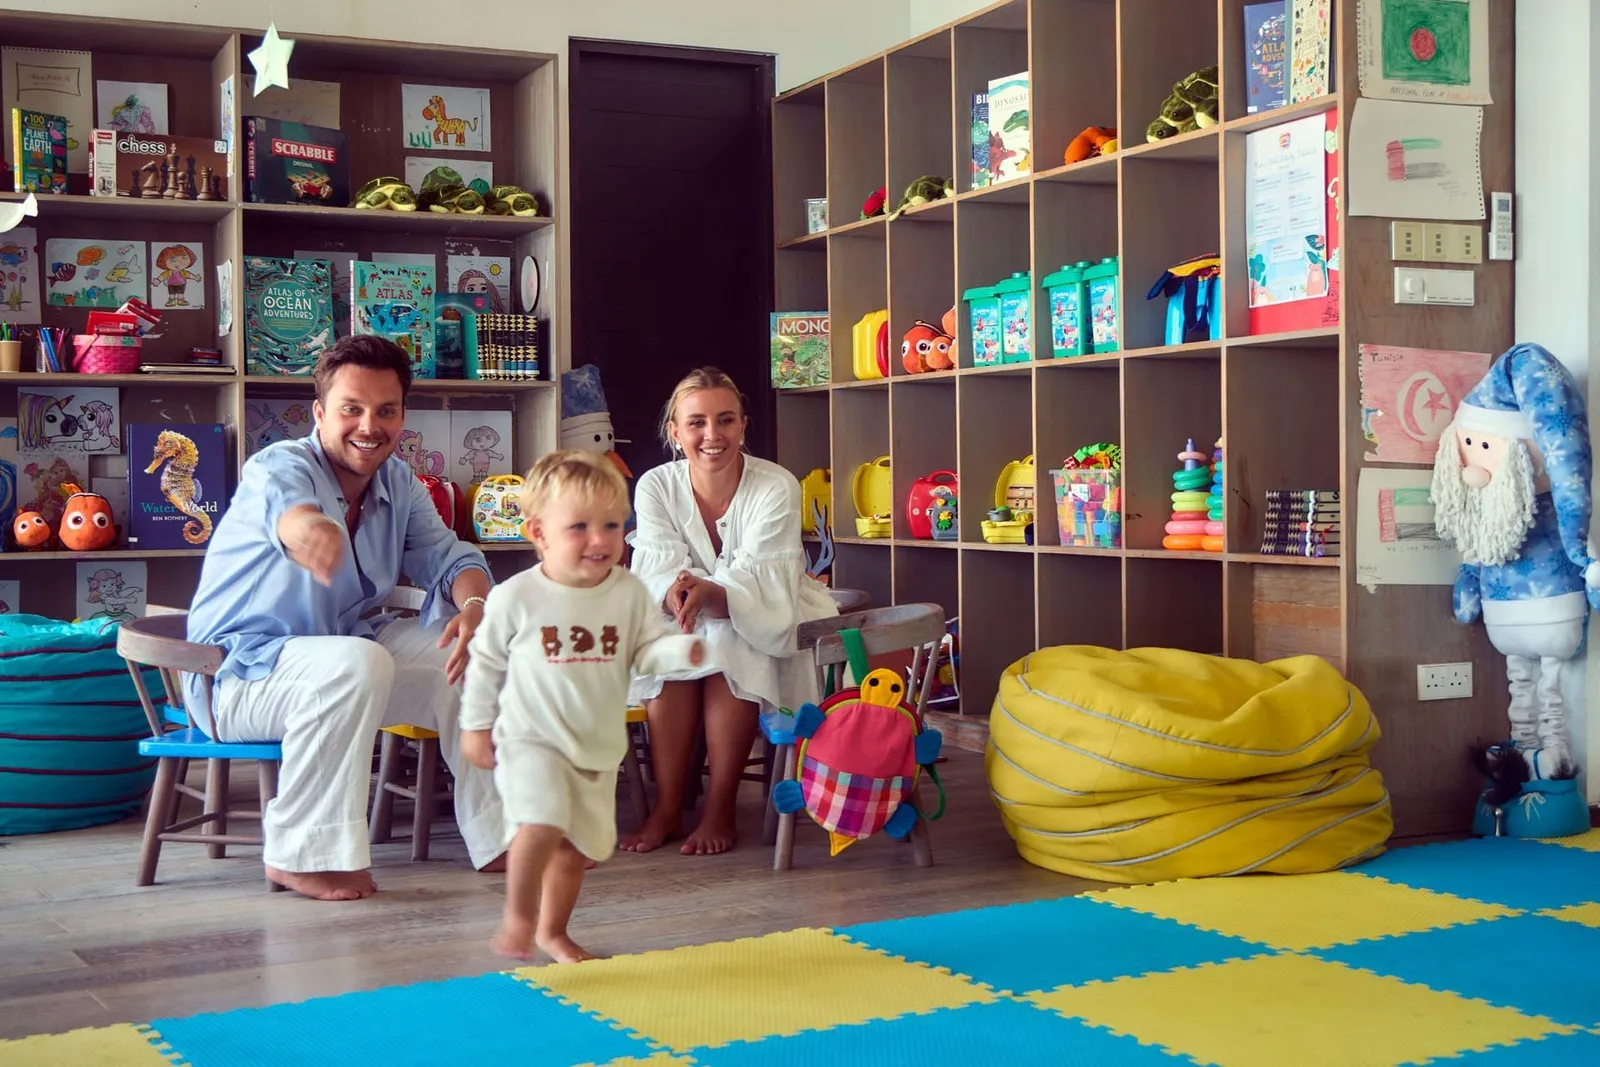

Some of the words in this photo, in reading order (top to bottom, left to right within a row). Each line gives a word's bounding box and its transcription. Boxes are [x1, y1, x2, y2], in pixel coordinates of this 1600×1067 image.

[29, 113, 45, 125] 100
[26, 128, 49, 141] PLANET
[23, 137, 52, 154] EARTH
[118, 134, 167, 155] chess
[274, 141, 335, 162] SCRABBLE
[292, 160, 314, 169] ORIGINAL
[268, 287, 293, 297] ATLAS
[294, 289, 306, 297] OF
[376, 287, 414, 300] ATLAS
[263, 296, 312, 311] OCEAN
[263, 308, 314, 320] ADVENTURES
[141, 502, 176, 513] Water
[181, 501, 218, 513] World
